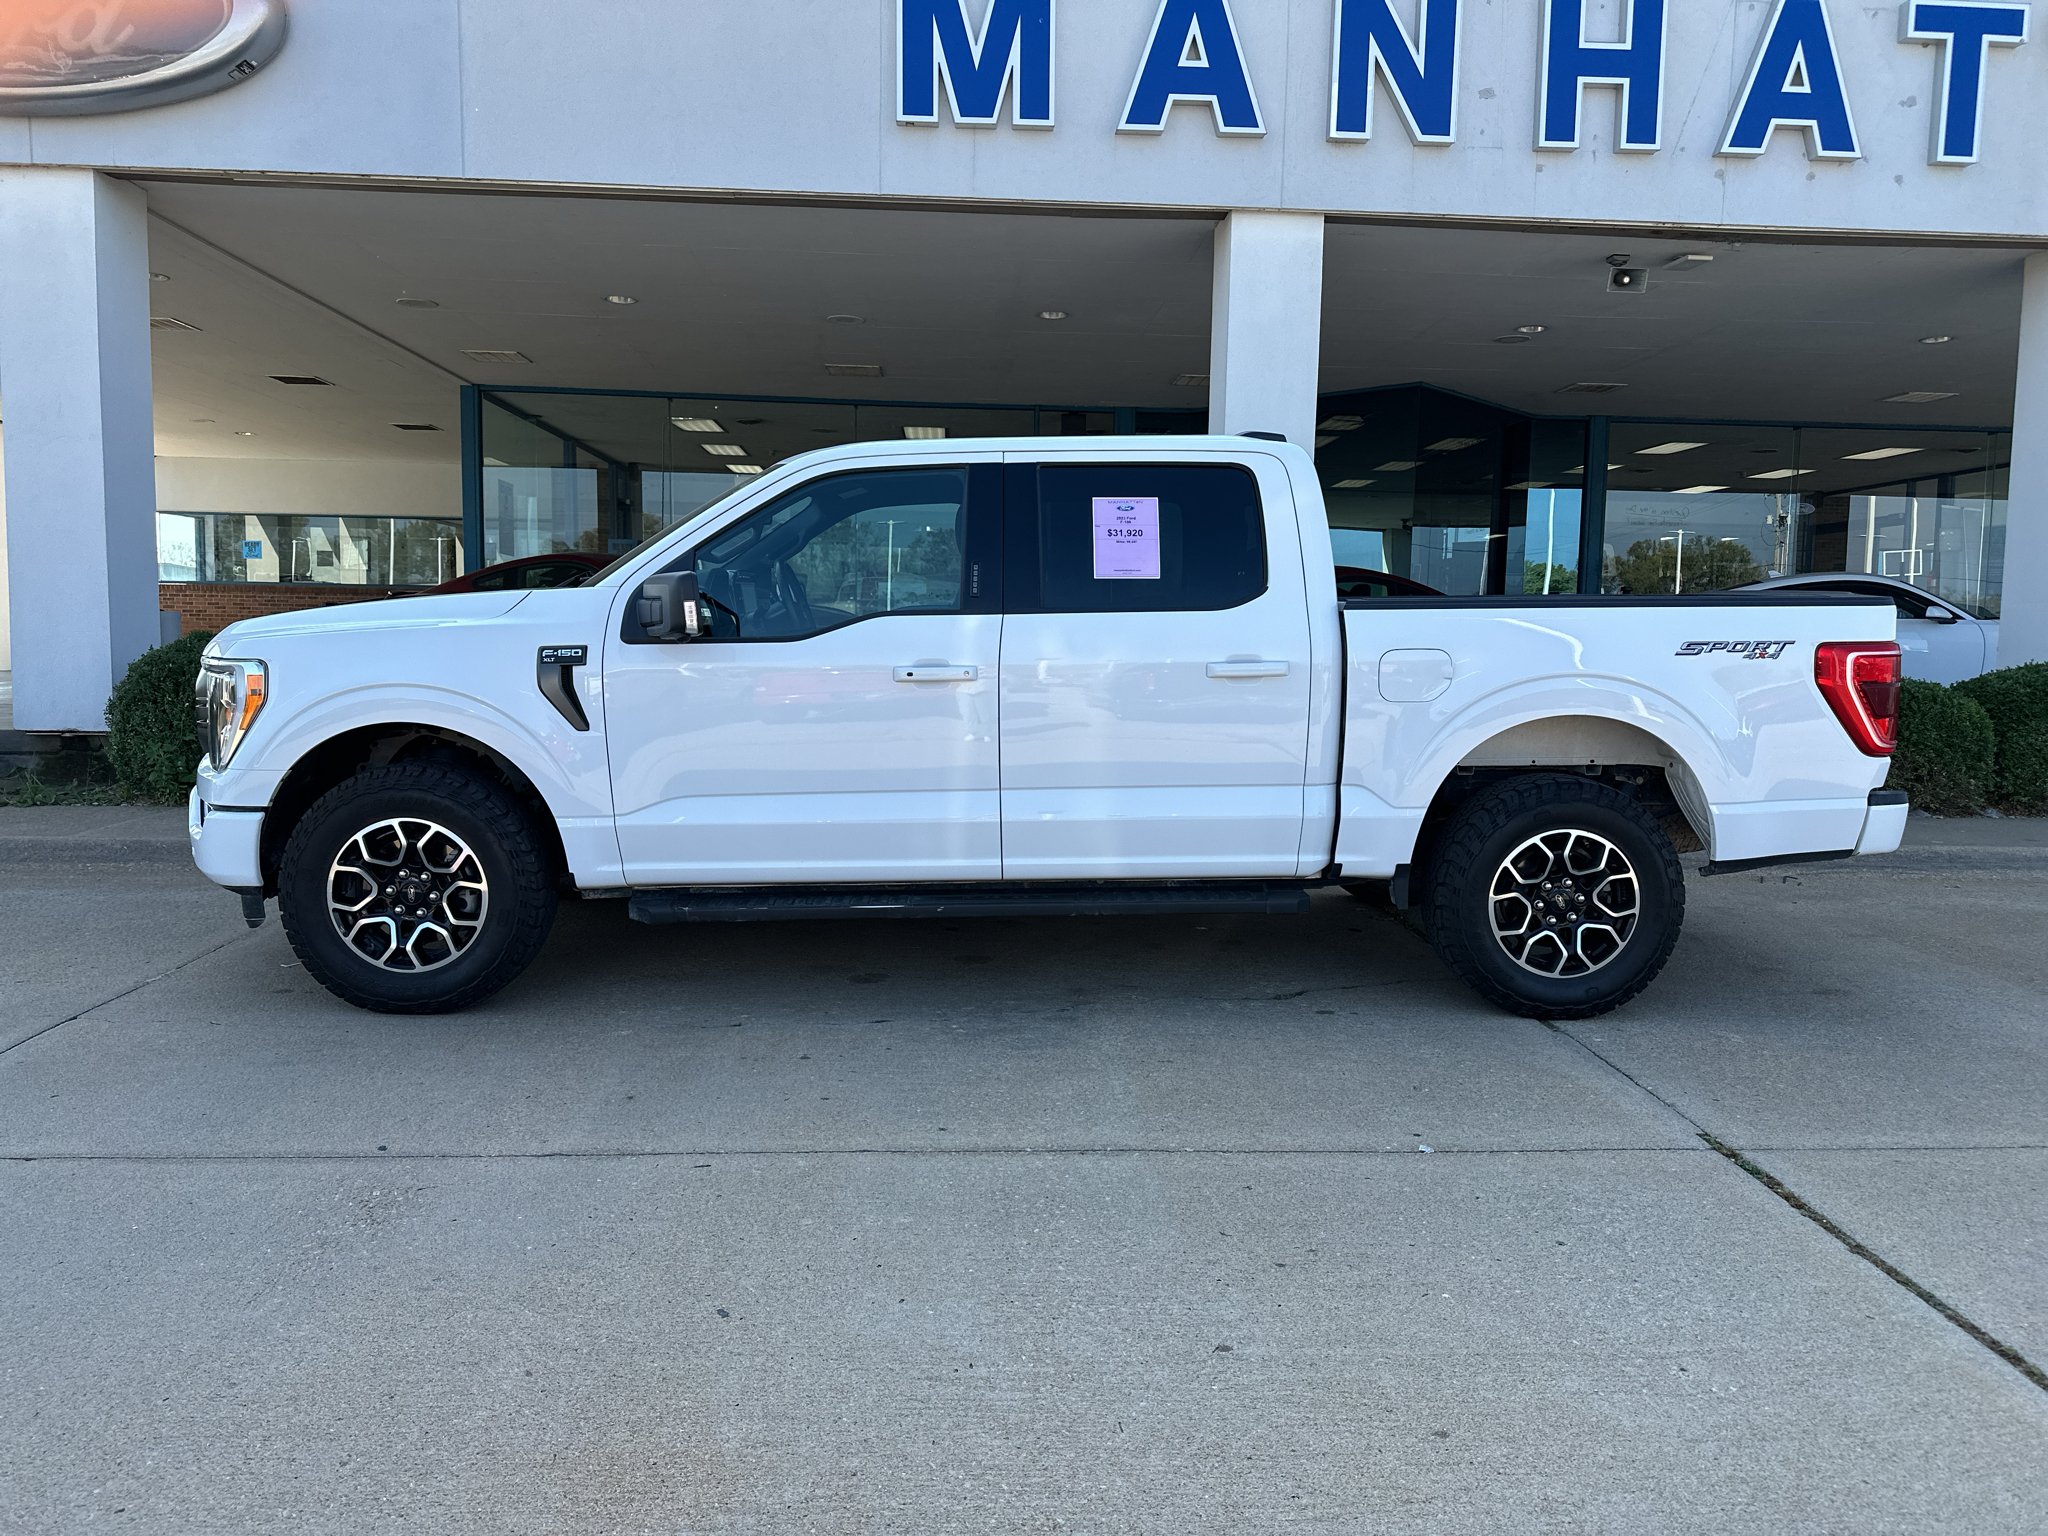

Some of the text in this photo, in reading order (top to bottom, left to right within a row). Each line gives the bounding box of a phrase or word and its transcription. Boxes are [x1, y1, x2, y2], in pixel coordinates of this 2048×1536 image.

[897, 0, 2031, 167] MANHAT
[1107, 528, 1144, 538] $31,920
[542, 649, 582, 657] F-150
[1674, 640, 1796, 656] SPORT
